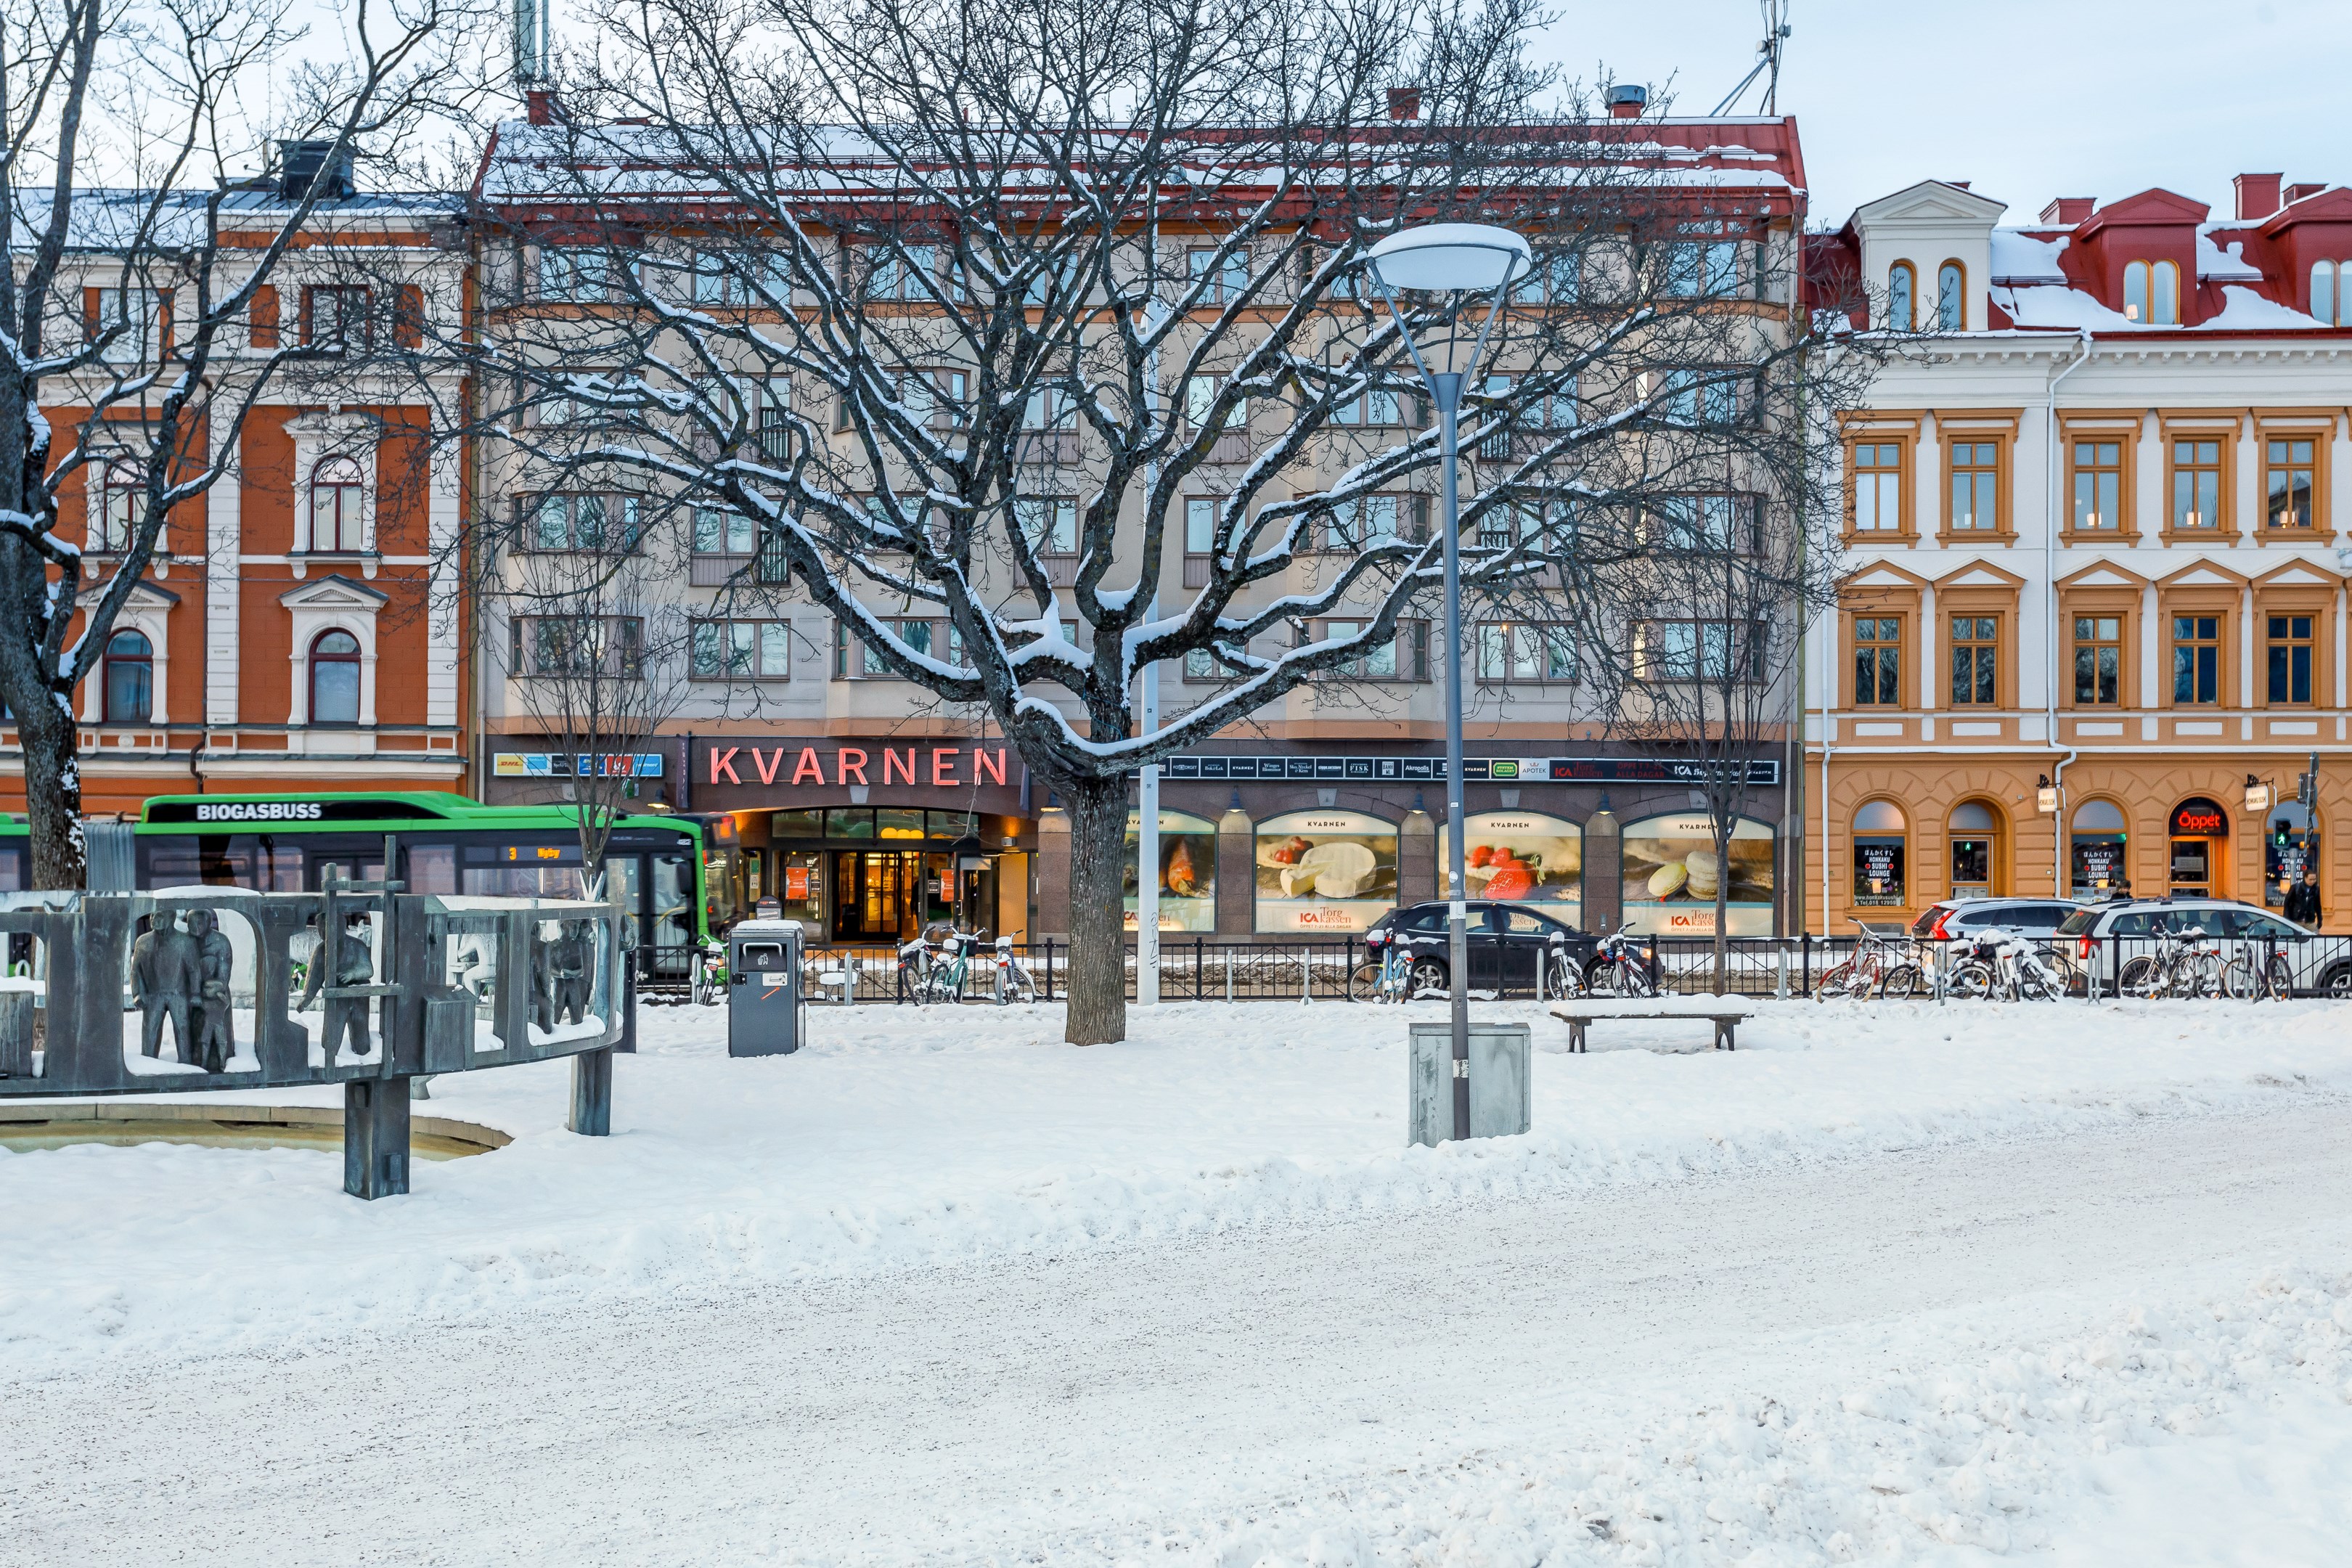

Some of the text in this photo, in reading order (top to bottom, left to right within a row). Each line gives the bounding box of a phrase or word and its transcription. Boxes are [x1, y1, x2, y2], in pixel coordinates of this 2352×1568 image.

[711, 747, 1006, 785] KVARNEN
[1674, 765, 1692, 775] ICA
[1555, 767, 1572, 777] ICA
[197, 803, 322, 820] BIOGASBUSS
[2179, 811, 2221, 830] Öppet
[509, 847, 517, 860] 3
[1300, 912, 1319, 923] ICA
[1320, 907, 1343, 917] Torg
[1320, 912, 1351, 923] kassen
[1691, 910, 1715, 920] Torg
[1671, 915, 1690, 926] ICA
[1691, 915, 1715, 926] kasse
